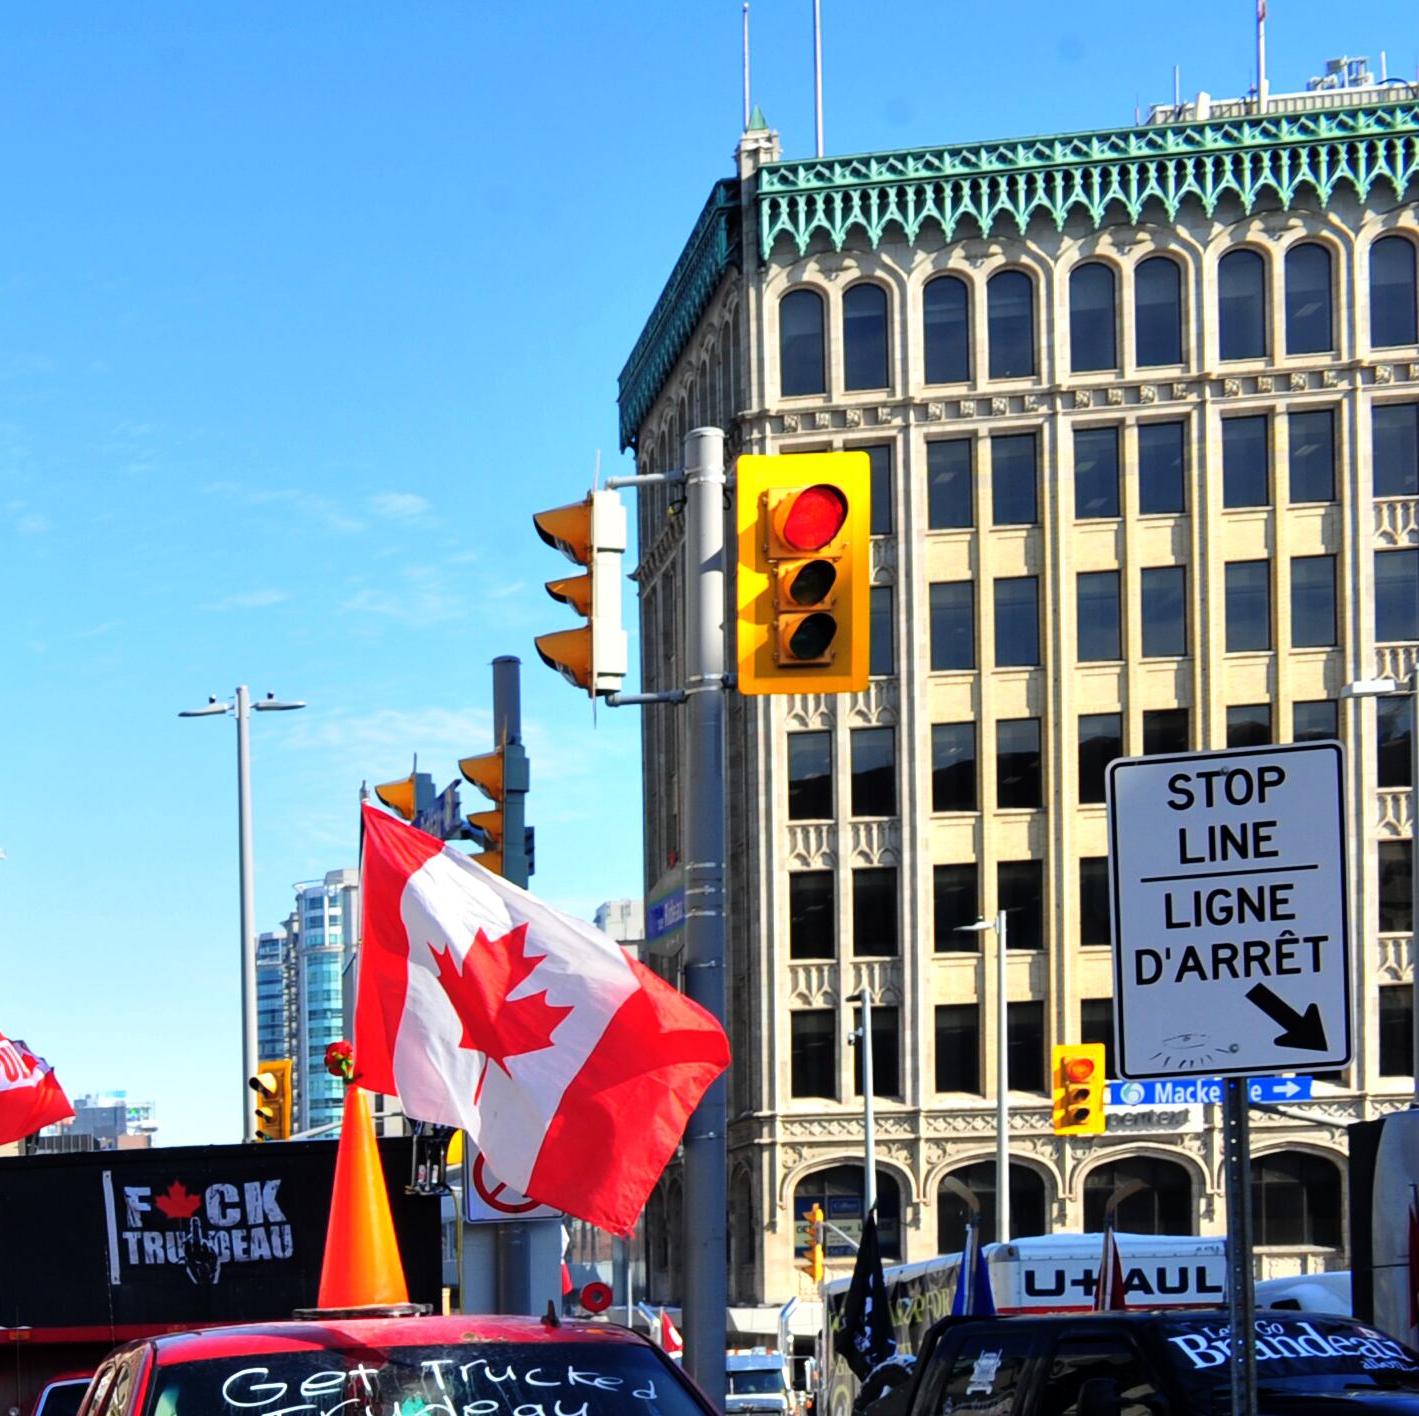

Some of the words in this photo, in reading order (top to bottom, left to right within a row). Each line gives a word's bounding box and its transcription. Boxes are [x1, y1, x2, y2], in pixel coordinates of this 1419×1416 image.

[1166, 765, 1286, 812] STOP
[1178, 820, 1279, 865] LINE
[1163, 883, 1296, 930] LIGNE
[1134, 930, 1329, 986] D'ARRÊT
[1155, 1079, 1262, 1104] Mackee
[221, 1364, 378, 1408] Get
[421, 1359, 660, 1401] Trucked
